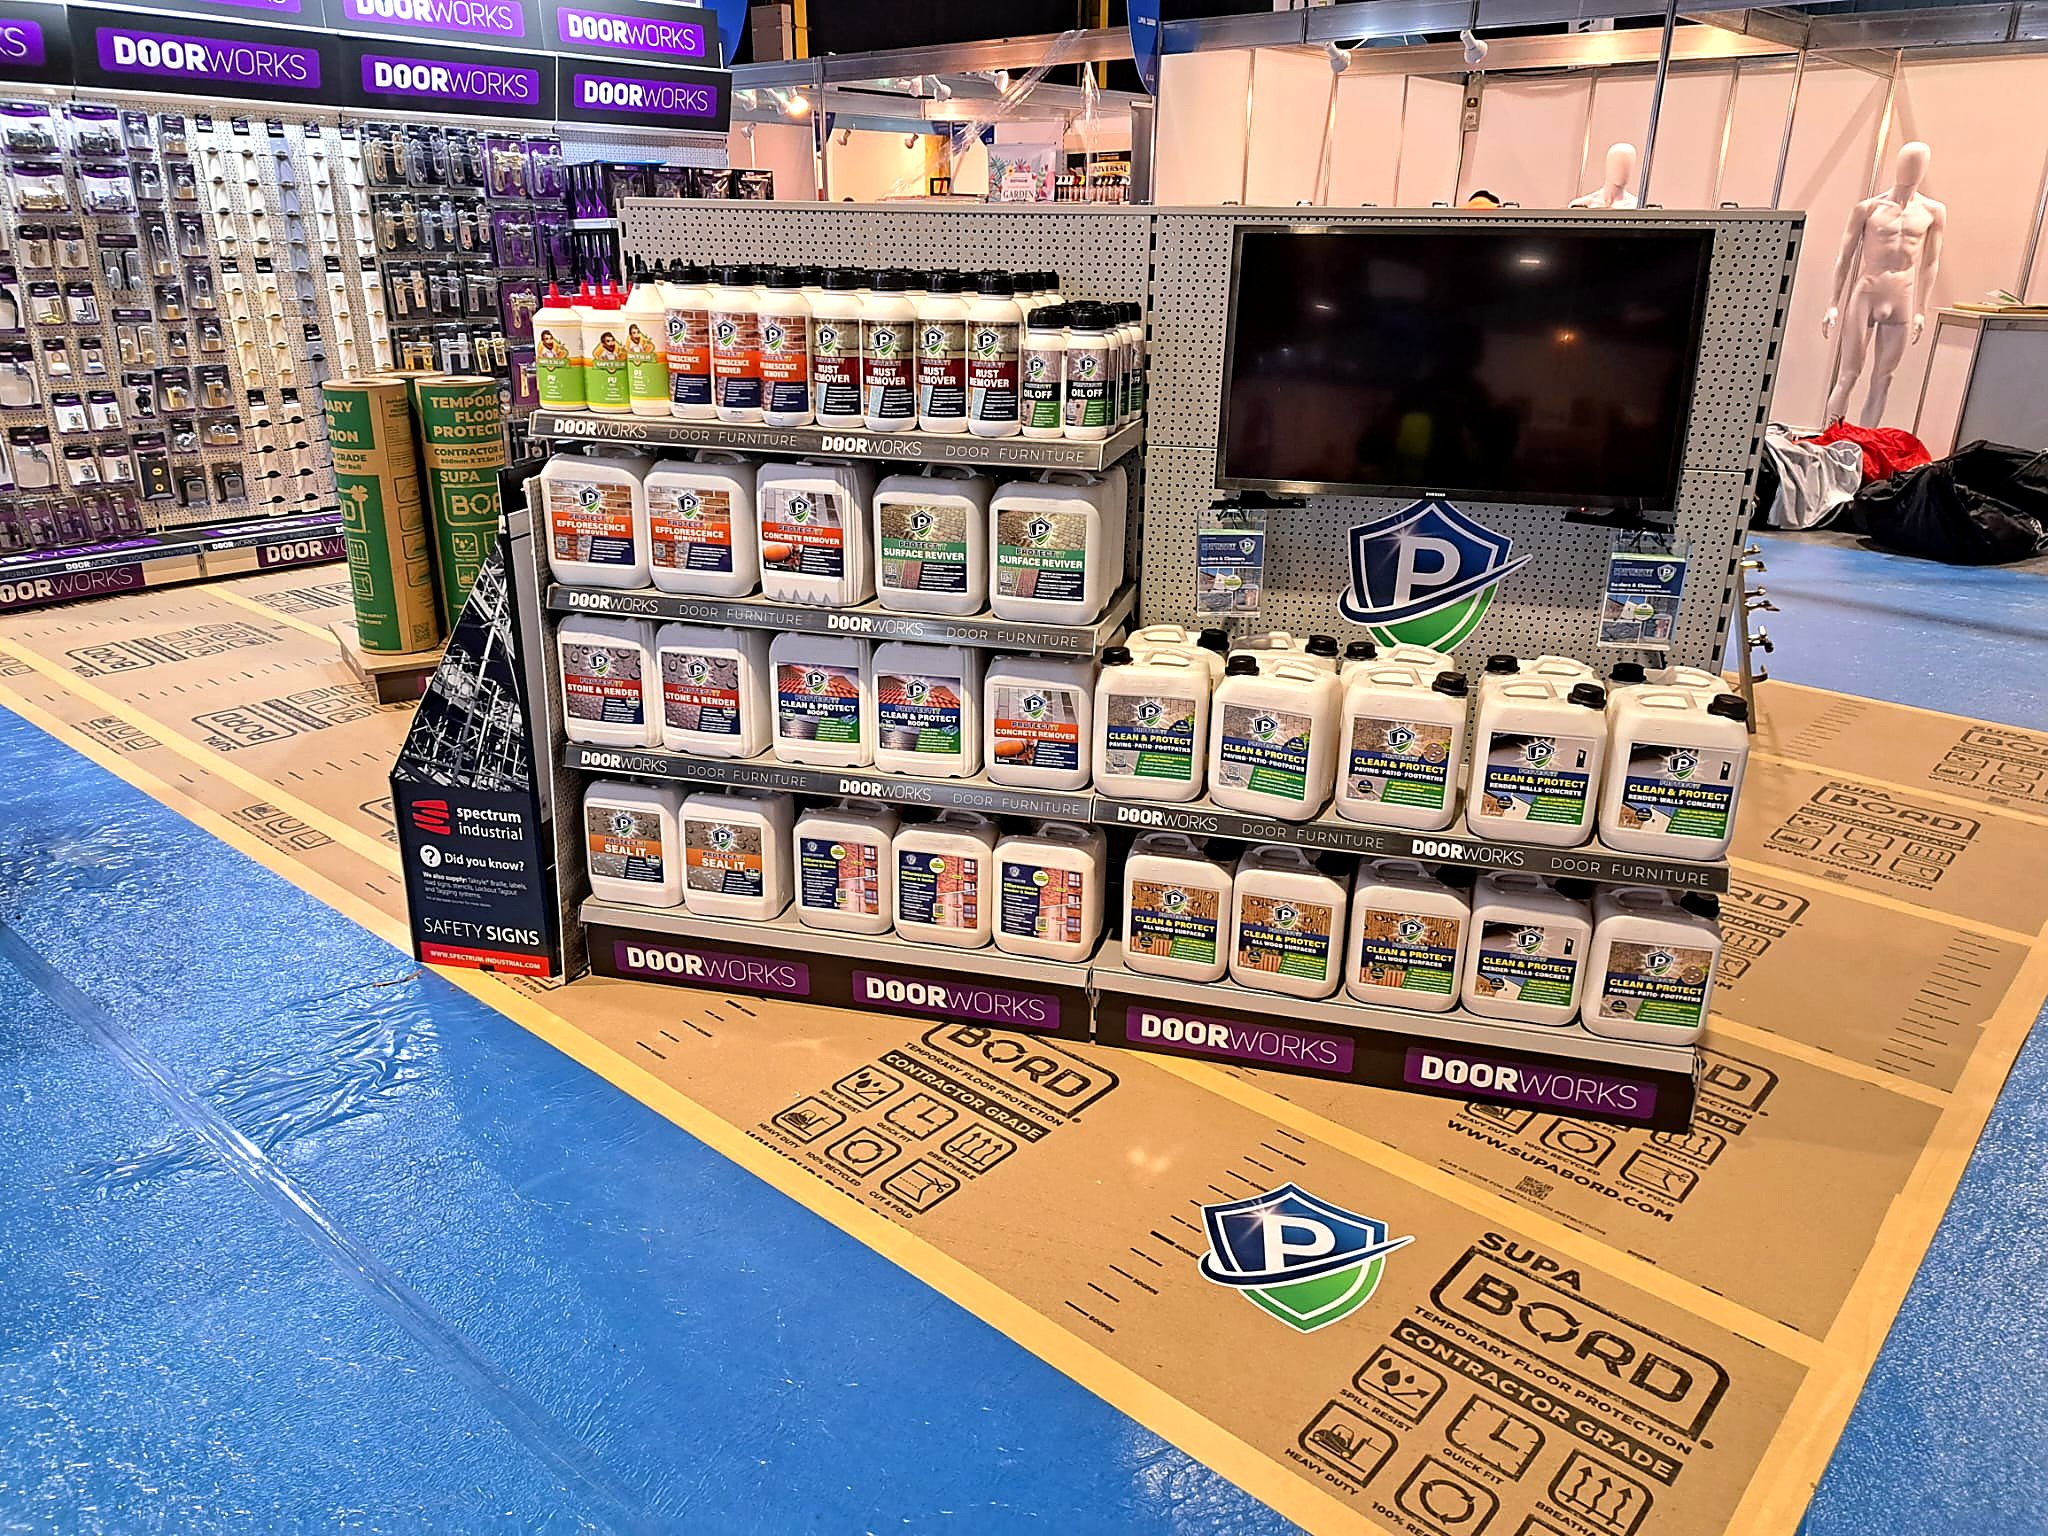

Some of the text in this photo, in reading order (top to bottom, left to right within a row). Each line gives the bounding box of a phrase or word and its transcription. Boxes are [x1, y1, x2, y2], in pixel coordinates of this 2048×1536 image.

[356, 0, 513, 30] DOORWORKS
[568, 13, 695, 51] DOORWORKS
[113, 36, 307, 80] DOORWORKS
[375, 61, 528, 98] DOORWORKS
[584, 80, 708, 112] DOORWORKS
[818, 364, 839, 373] RUST
[873, 367, 896, 377] RUST
[923, 366, 946, 376] RUST
[975, 369, 999, 378] RUST
[1035, 391, 1053, 399] OFF
[1071, 389, 1103, 398] OIL OFF
[454, 408, 499, 423] FLOOR
[434, 446, 498, 456] CONTRACTOR
[554, 420, 1085, 463] DOORWORKS DOOR FURNITURE DOORWORKS DOOR FURNITURE
[440, 471, 480, 483] SUPA
[557, 520, 626, 532] EFFLORESCENCE
[655, 526, 724, 539] EFFLORESCENCE
[212, 538, 258, 550] DOORWORKS
[674, 535, 706, 543] REMOVER
[763, 532, 840, 546] CONCRETE REMOVER
[883, 547, 965, 561] SURFACE REVIVER
[1000, 555, 1083, 569] SURFACE REVIVER
[65, 558, 119, 571] DOORWORKS
[569, 592, 1078, 648] DOORWORKS DOOR FURNITURE DOORWORKS DOOR FURNITURE
[567, 683, 639, 697] STONE RENDER
[665, 692, 736, 707] STONE RENDER
[781, 699, 856, 713] CLEAN PROTECT
[807, 709, 829, 717] ROOFS
[881, 711, 957, 723] CLEAN PROTECT
[996, 728, 1075, 741] CONCRETE REMOVER
[1109, 733, 1192, 746] CLEAN PROTECT
[1223, 743, 1306, 764] CLEAN PROTECT
[1355, 757, 1446, 774] CLEAN PROTECT
[581, 751, 1080, 815] DOORWORKS DOOR FURNITURE DOORWORKS DOOR FURNITURE
[1490, 772, 1585, 789] CLEAN PROTECT
[1629, 784, 1729, 802] CLEAN PROTECT
[1828, 781, 1891, 800] SUPA
[457, 806, 522, 824] spectrum
[1829, 793, 1963, 831] BORD
[458, 822, 524, 841] industrial
[604, 844, 634, 856] SEAL
[1117, 807, 1710, 886] DOORWORKS DOOR FURNITURE DOORWORKS DOOR FURNITURE
[444, 853, 525, 872] Did you know?
[701, 857, 732, 870] SEAL
[423, 917, 540, 946] SAFETY SIGNS
[1135, 915, 1215, 933] CLEAN PROTECT
[1244, 930, 1327, 949] CLEAN PROTECT
[1367, 945, 1454, 962] CLEAN PROTECT
[626, 945, 797, 988] DOORWORKS
[1482, 956, 1573, 974] CLEAN PROTECT
[1609, 978, 1704, 996] CLEAN PROTECT
[866, 976, 1046, 1022] DOORWORKS
[1141, 1013, 1338, 1065] DOORWORKS
[948, 1026, 1092, 1098] BORD
[904, 1042, 1064, 1127] TEMPORARY FLOOR PROTECTION
[1421, 1055, 1638, 1111] DOORWORKS
[886, 1054, 1042, 1141] CONTRACTOR GRADE
[876, 1122, 913, 1144] QUICK FIT
[1455, 1112, 1514, 1138] HEAVY DUTY
[757, 1122, 802, 1149] HEAVY DUTY
[926, 1150, 977, 1181] BREATHABLE
[1641, 1142, 1708, 1171] BREATHABLE
[823, 1162, 862, 1187] RECYCLED
[1447, 1119, 1674, 1223] WWW.SUPABORD.COM
[1615, 1180, 1675, 1208] CUT FOLD
[869, 1190, 914, 1219] CUT FOLD
[1478, 1232, 1583, 1292] SUPA
[1463, 1273, 1694, 1403] BORD
[1414, 1305, 1693, 1456] TEMPORARY FLOOR PROTECTION
[1339, 1388, 1415, 1433] SPILL RESIST
[1401, 1326, 1674, 1479] CONTRACTOR GRADE
[1284, 1447, 1360, 1497] HEAVY DUTY
[1442, 1447, 1505, 1486] QUICK FIT
[1371, 1501, 1404, 1526] 100%
